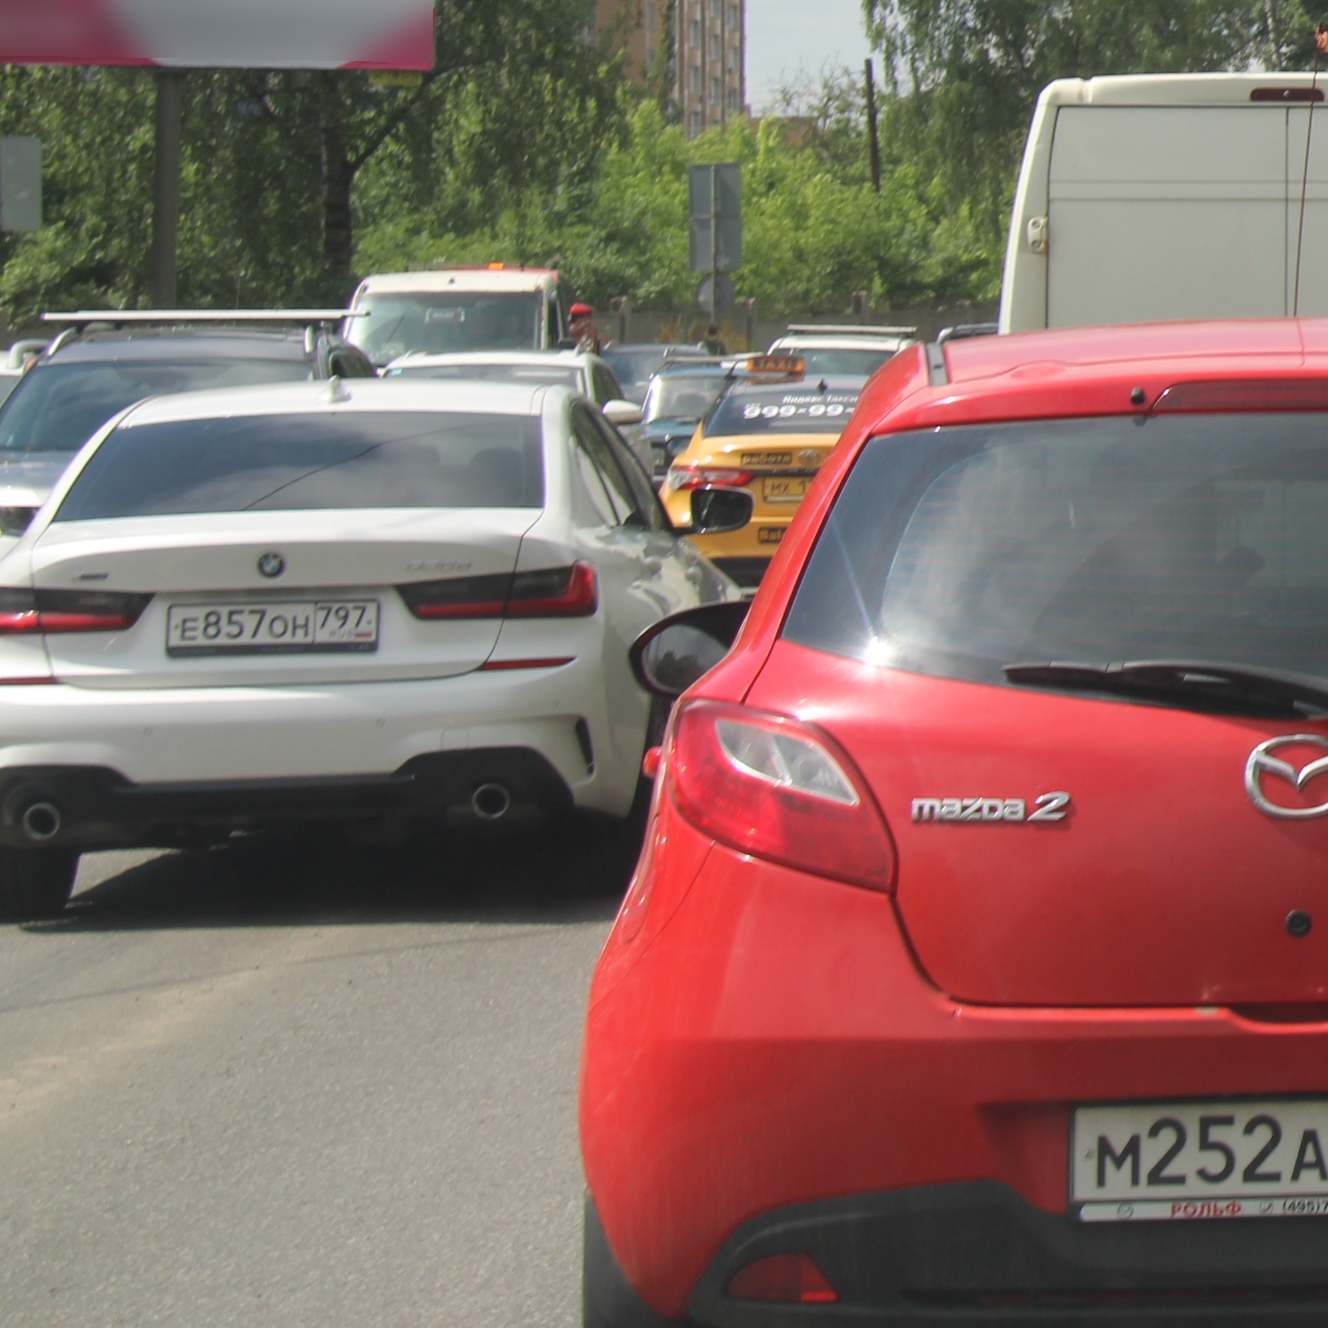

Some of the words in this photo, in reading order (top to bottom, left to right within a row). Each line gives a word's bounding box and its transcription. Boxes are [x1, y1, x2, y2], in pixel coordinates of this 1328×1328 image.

[180, 608, 309, 642] Е857ОН
[317, 606, 367, 630] 797
[911, 796, 1026, 822] mazda
[1027, 791, 1071, 821] 2
[1169, 1201, 1243, 1217] РОЛЬФ
